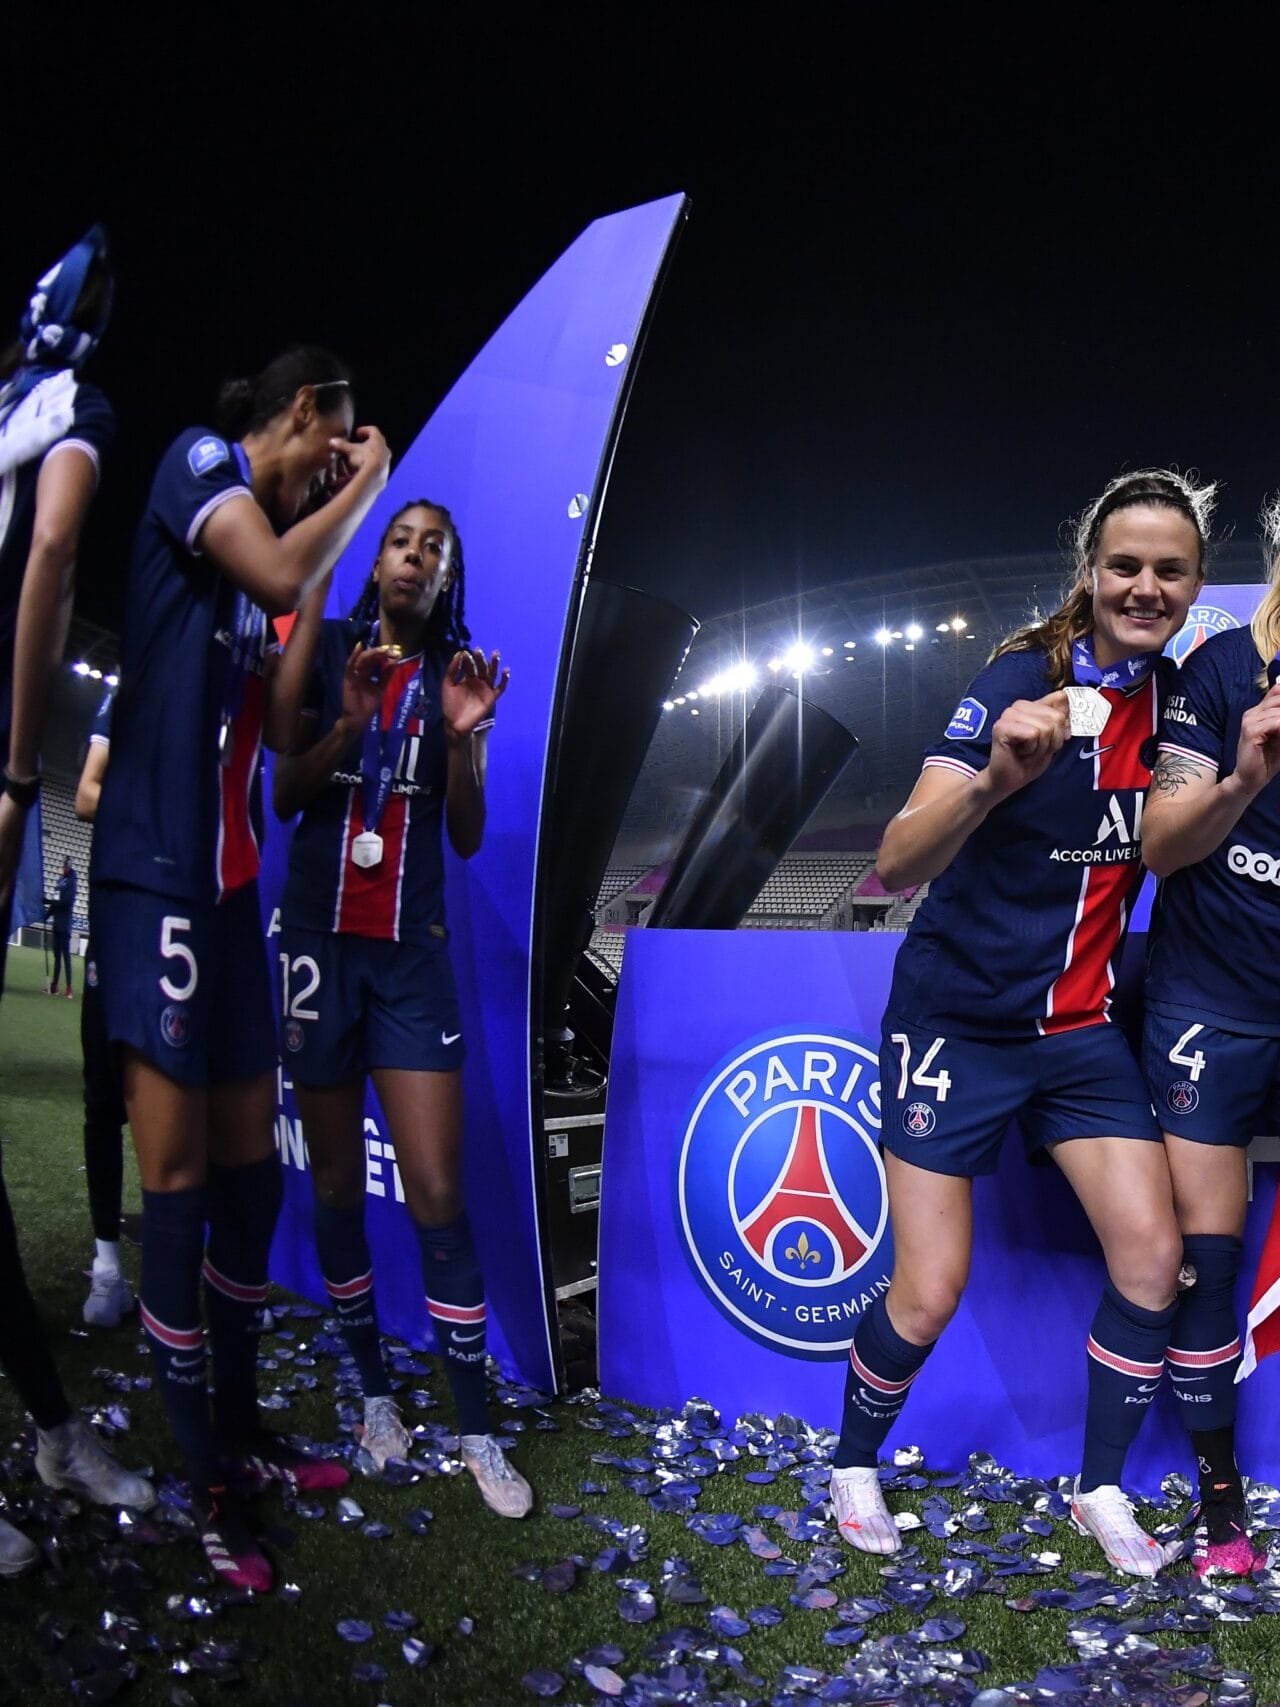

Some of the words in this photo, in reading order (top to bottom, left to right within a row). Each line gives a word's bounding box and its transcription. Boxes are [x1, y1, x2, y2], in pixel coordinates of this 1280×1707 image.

[1187, 610, 1231, 631] RIS
[954, 707, 972, 721] D1
[1164, 708, 1197, 726] ANDA
[1049, 848, 1102, 863] ACCOR
[1105, 847, 1132, 862] LIVE
[160, 915, 198, 1001] 5
[279, 952, 321, 1020] 12
[891, 1033, 951, 1102] 14
[1169, 1023, 1206, 1082] 4
[908, 1104, 930, 1115] PARIS
[719, 1251, 776, 1310] SAINT
[795, 1274, 892, 1324] GERMAIN
